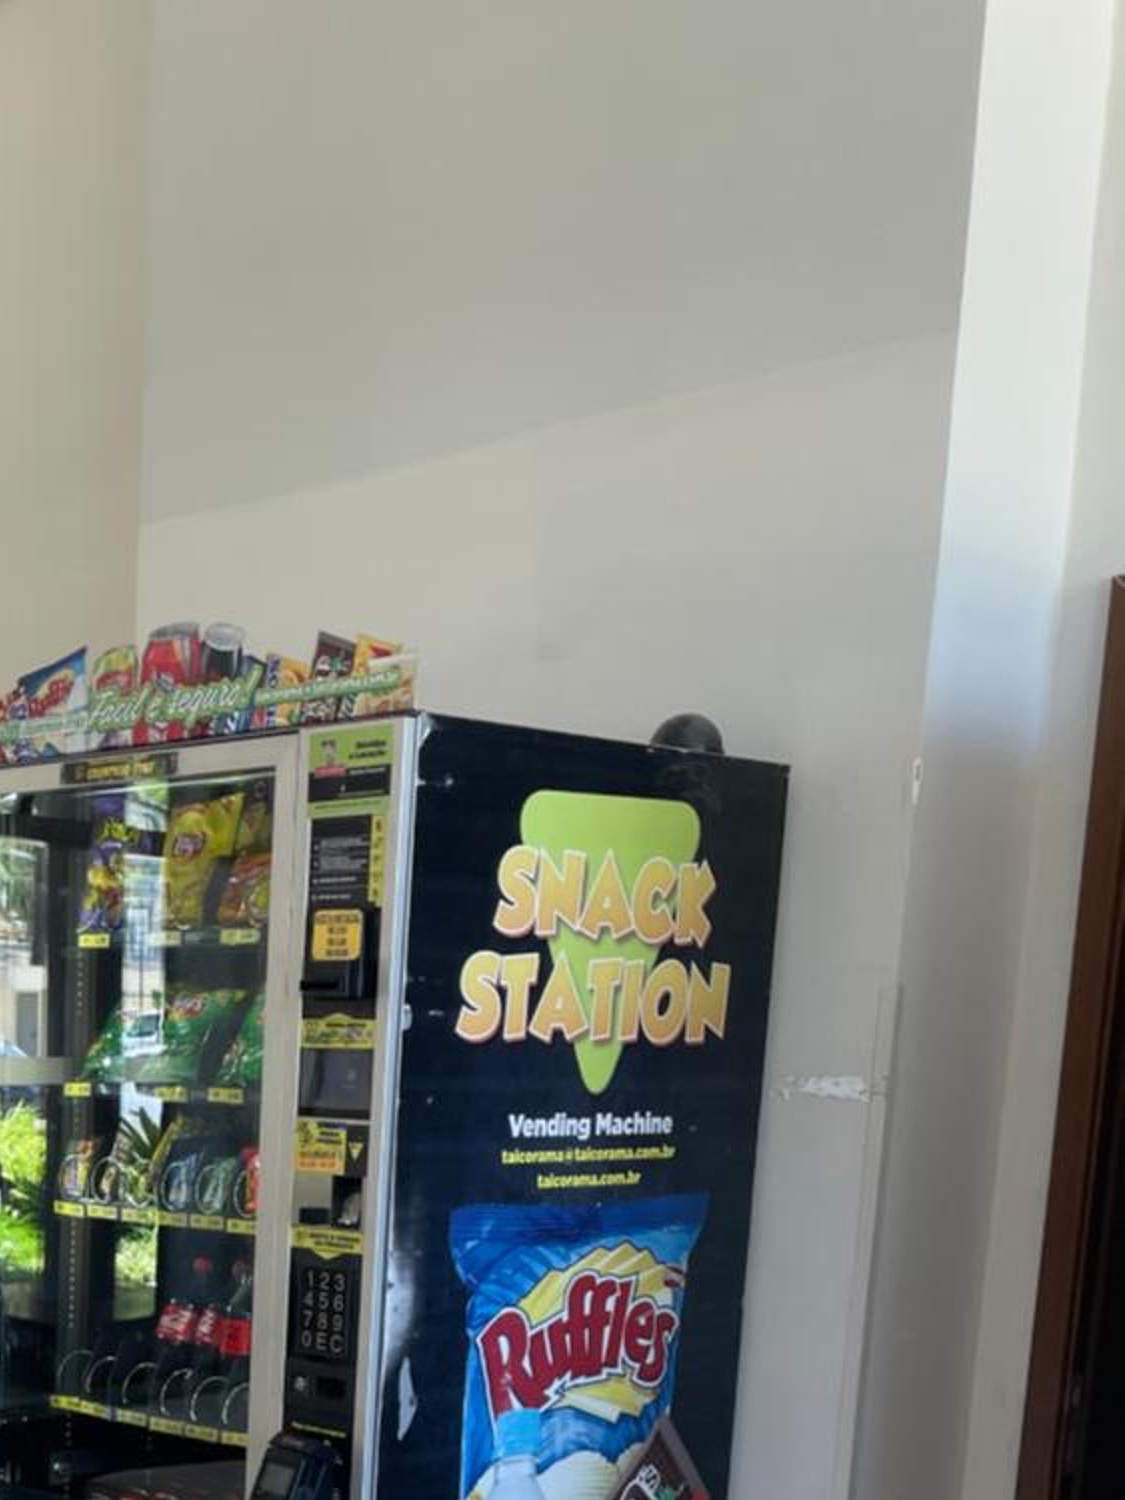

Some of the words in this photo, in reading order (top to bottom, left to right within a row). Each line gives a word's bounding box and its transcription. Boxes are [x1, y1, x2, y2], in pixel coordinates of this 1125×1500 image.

[493, 844, 716, 948] SNACK
[455, 950, 731, 1046] STATION
[508, 1112, 590, 1140] Vending
[595, 1111, 673, 1136] Machine
[318, 1272, 331, 1290] 2
[334, 1273, 345, 1291] 3
[303, 1310, 313, 1327] 7
[478, 1272, 680, 1413] Ruffles
